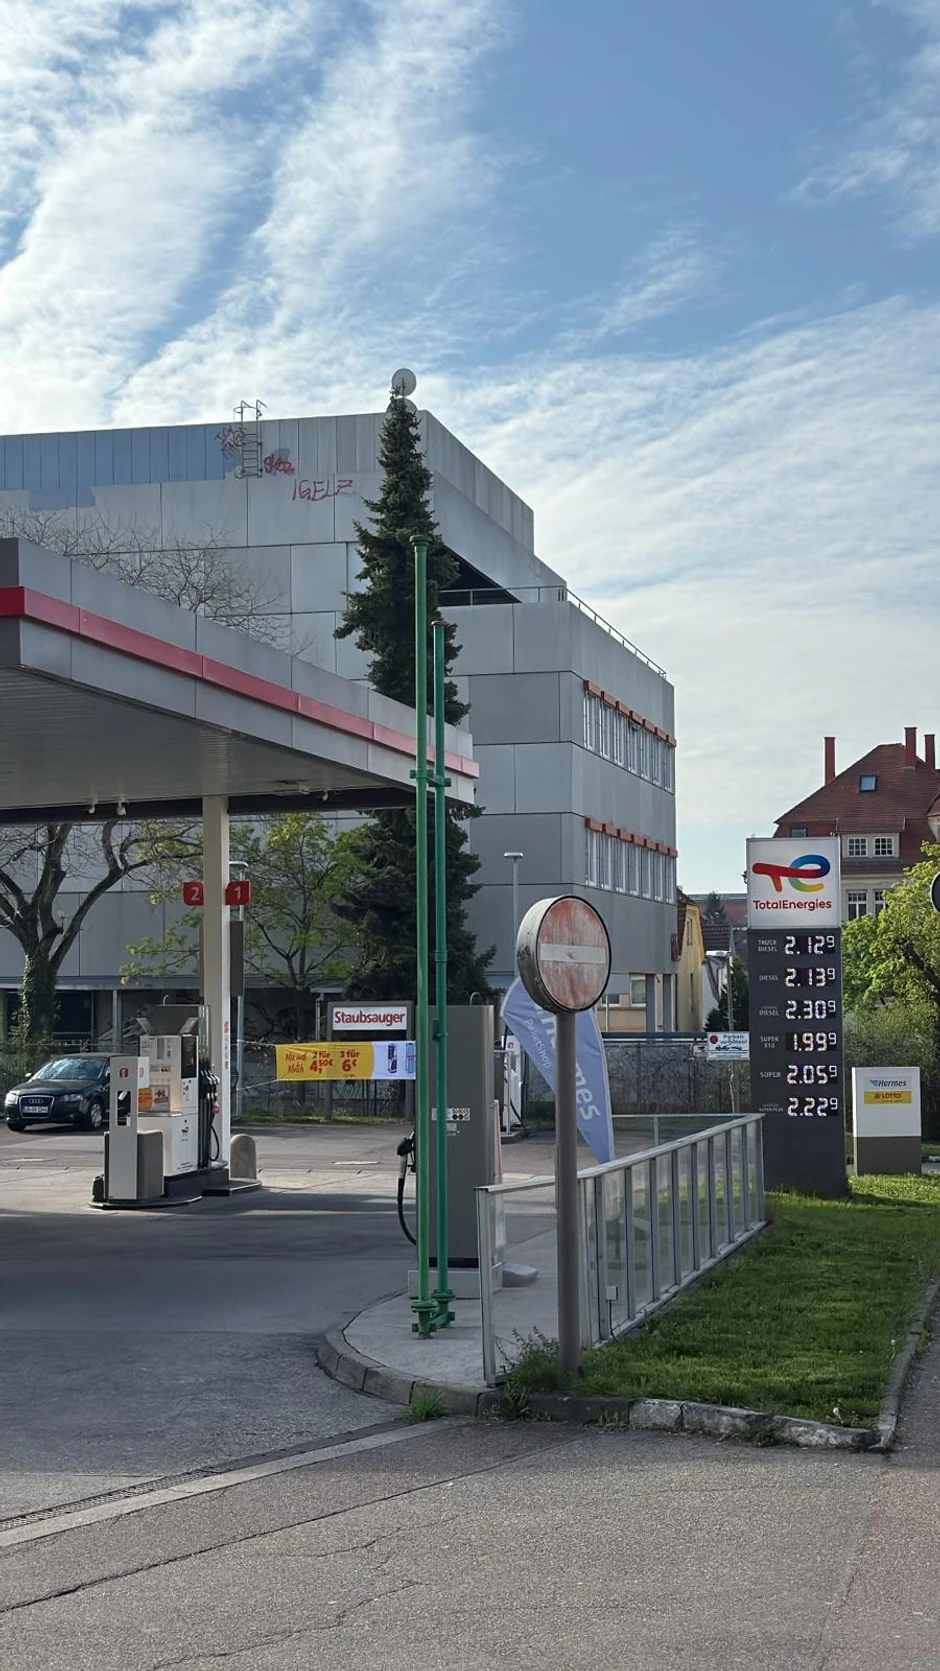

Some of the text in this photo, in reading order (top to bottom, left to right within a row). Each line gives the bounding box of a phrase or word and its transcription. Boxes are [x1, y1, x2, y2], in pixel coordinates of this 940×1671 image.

[191, 886, 201, 901] 2
[234, 886, 242, 900] 1
[753, 898, 832, 911] TotalEnergies
[785, 1000, 836, 1020] 2.309
[334, 1011, 406, 1026] Staubsauger
[793, 1032, 837, 1052] 1.999
[346, 1049, 360, 1058] für
[787, 1065, 838, 1085] 2.059
[788, 1097, 839, 1117] 2.229
